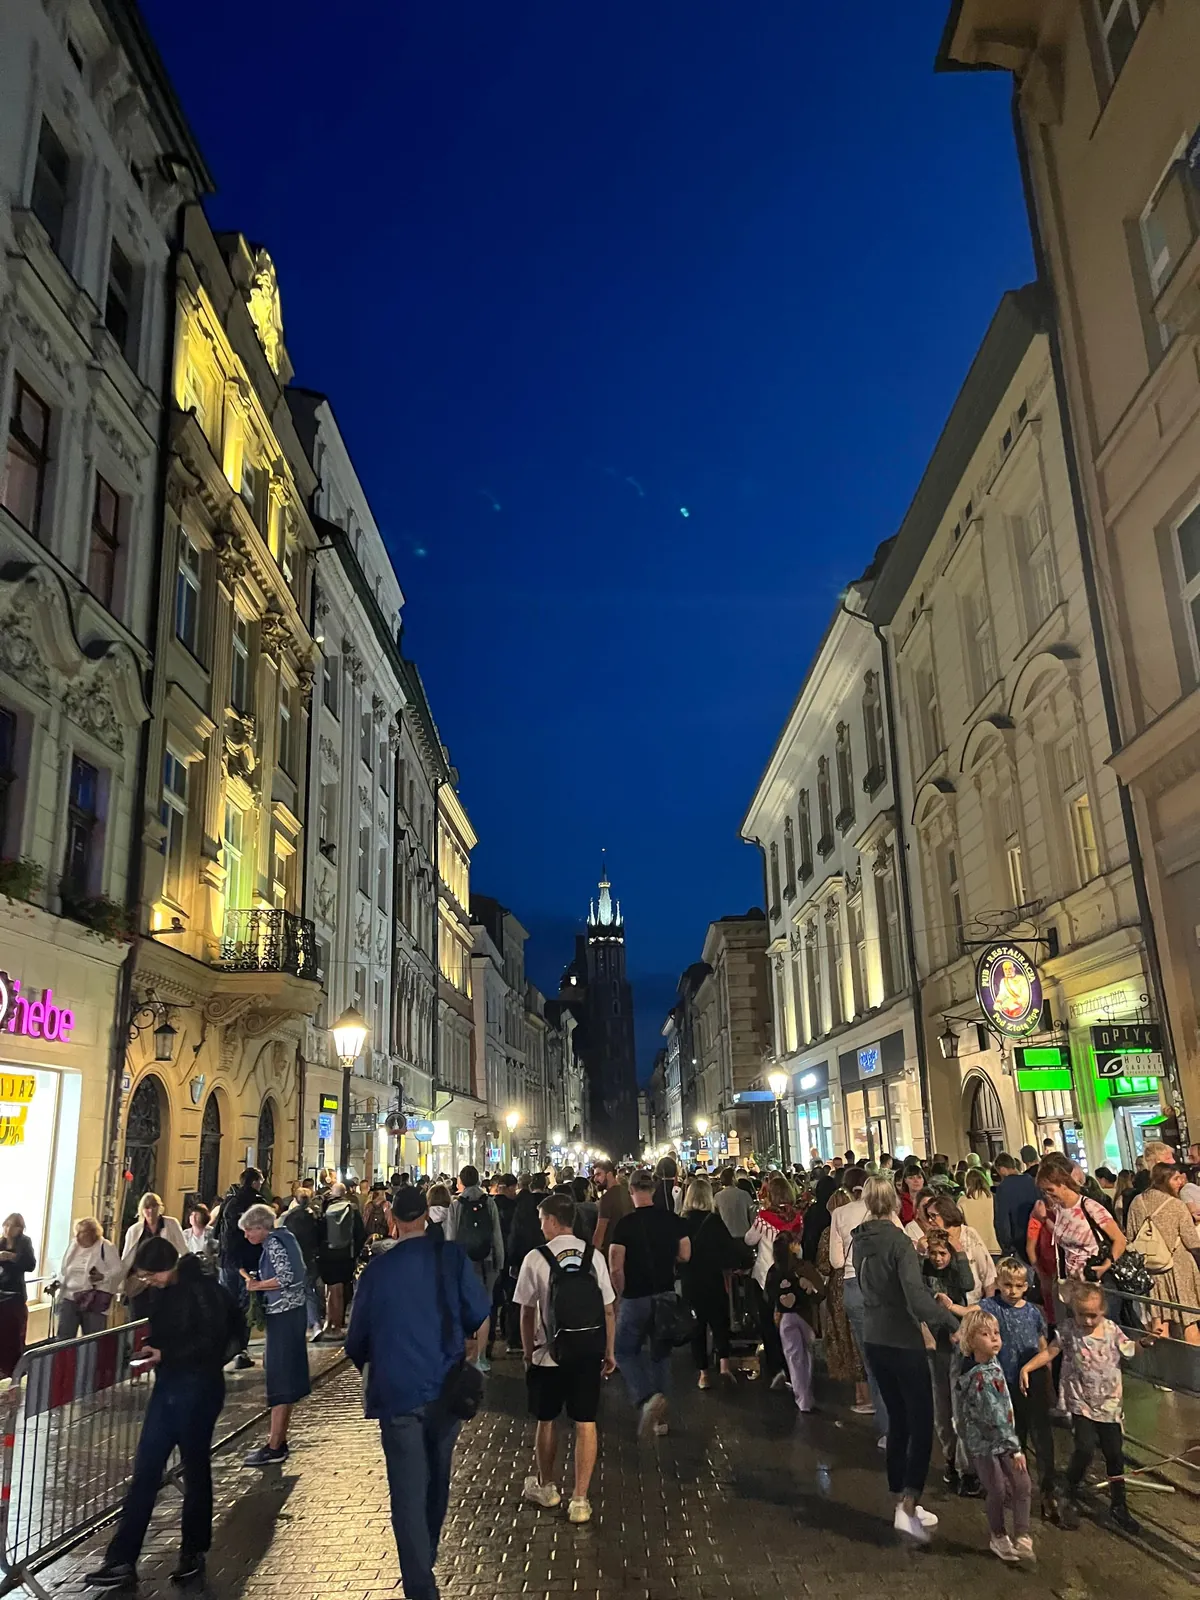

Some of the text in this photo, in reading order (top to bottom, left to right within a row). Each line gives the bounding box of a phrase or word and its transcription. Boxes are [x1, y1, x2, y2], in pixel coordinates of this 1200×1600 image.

[982, 947, 1036, 987] PUB RESTAURACJA
[993, 1012, 1007, 1027] Pod
[1102, 1027, 1152, 1046] OPTYK
[1124, 1055, 1162, 1064] HOSZ
